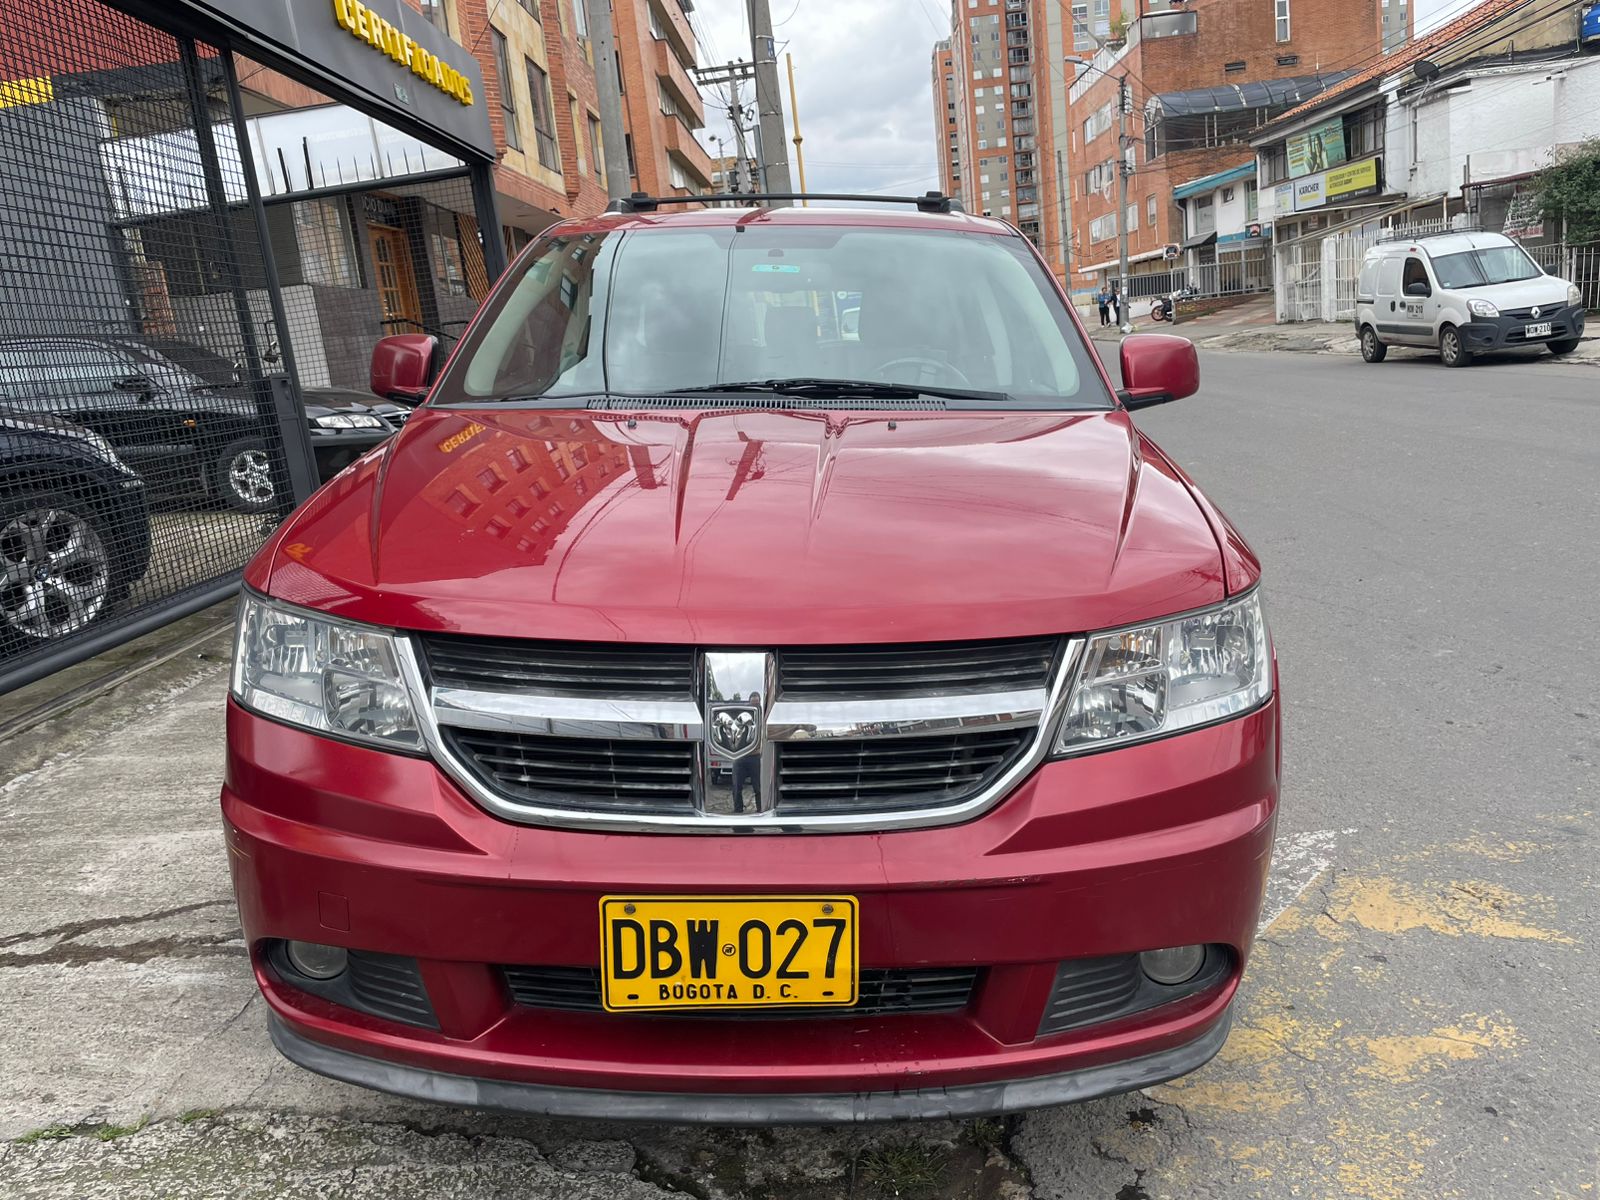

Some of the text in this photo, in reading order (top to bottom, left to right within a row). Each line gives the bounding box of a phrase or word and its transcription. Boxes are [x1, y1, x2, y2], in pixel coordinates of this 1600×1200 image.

[612, 919, 846, 979] DBW 027
[659, 984, 799, 1000] BOGOTA D. C.
